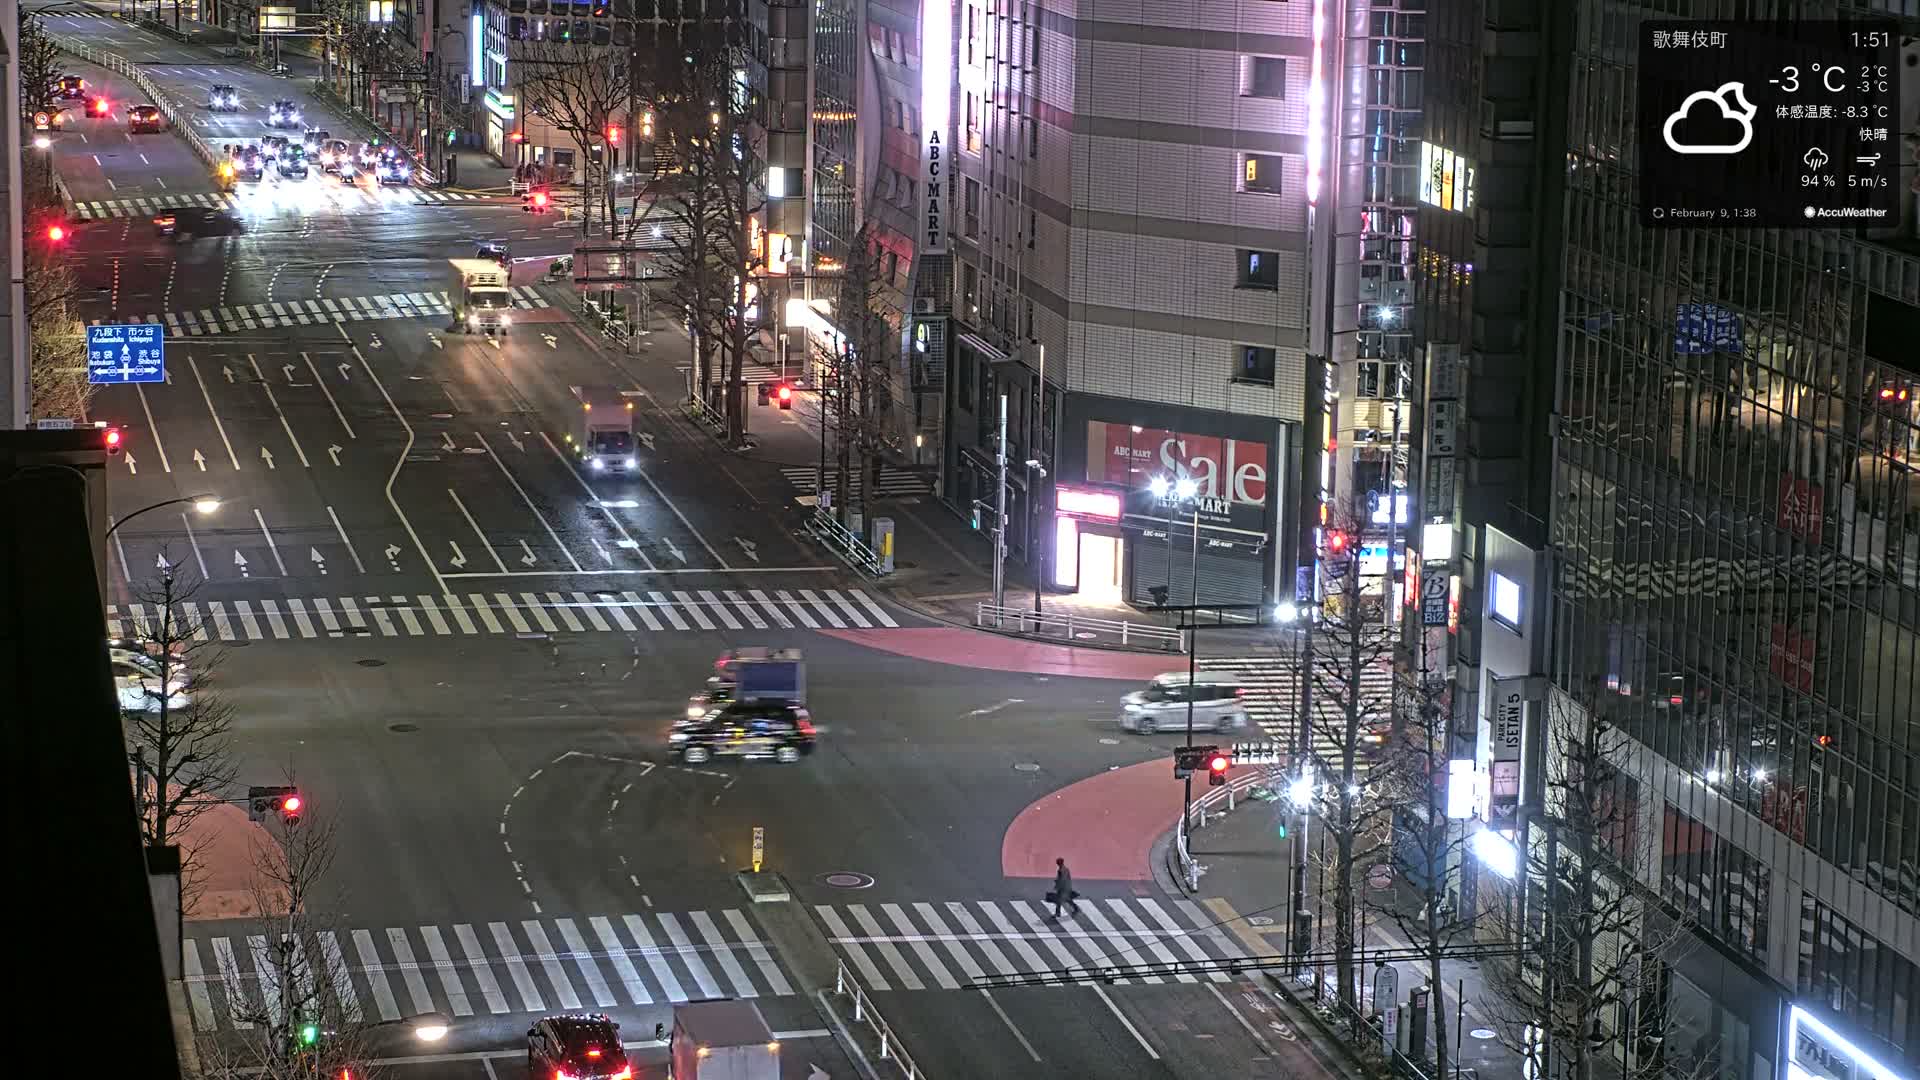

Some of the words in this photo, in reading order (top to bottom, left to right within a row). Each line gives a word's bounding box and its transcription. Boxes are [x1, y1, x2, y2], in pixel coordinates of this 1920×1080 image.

[94, 327, 123, 337] 九段下
[1114, 445, 1152, 458] ABCMART
[1160, 438, 1266, 508] Sale
[1508, 693, 1520, 704] 5
[1498, 704, 1507, 721] CITY
[1497, 722, 1507, 742] PARK
[1506, 706, 1519, 748] ISETAN
